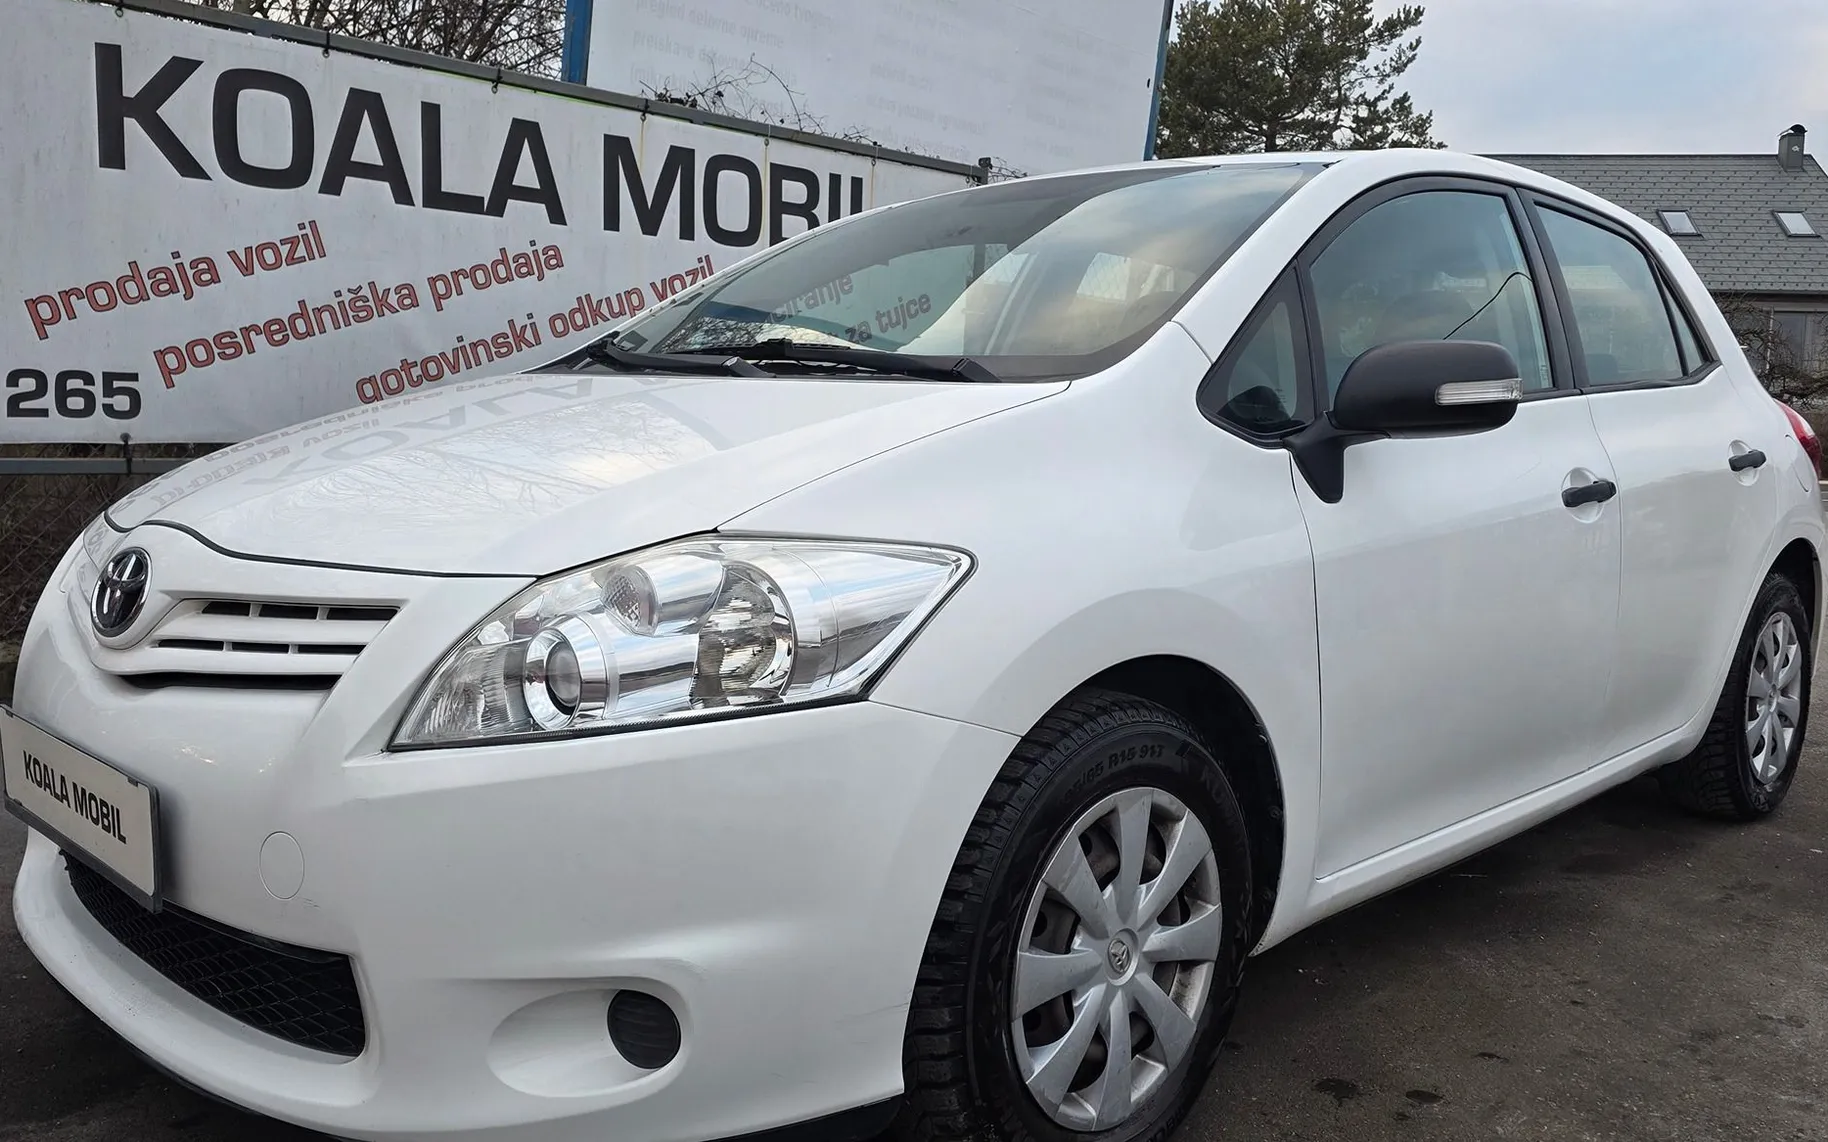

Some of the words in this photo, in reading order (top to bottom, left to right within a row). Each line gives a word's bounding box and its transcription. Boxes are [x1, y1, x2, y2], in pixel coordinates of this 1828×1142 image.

[95, 42, 567, 226] KOALA
[24, 250, 221, 341] prodaja
[227, 220, 327, 278] vozil
[153, 281, 421, 389] posredniška
[427, 240, 564, 311] prodaja
[355, 313, 542, 404] gotovinski
[549, 293, 645, 338] odkup
[650, 255, 715, 303] vozil
[844, 320, 872, 344] za
[875, 293, 932, 331] tujce
[6, 368, 142, 420] 265
[23, 750, 71, 809] KOALA
[72, 781, 127, 844] MOBIL
[1108, 747, 1137, 769] R15
